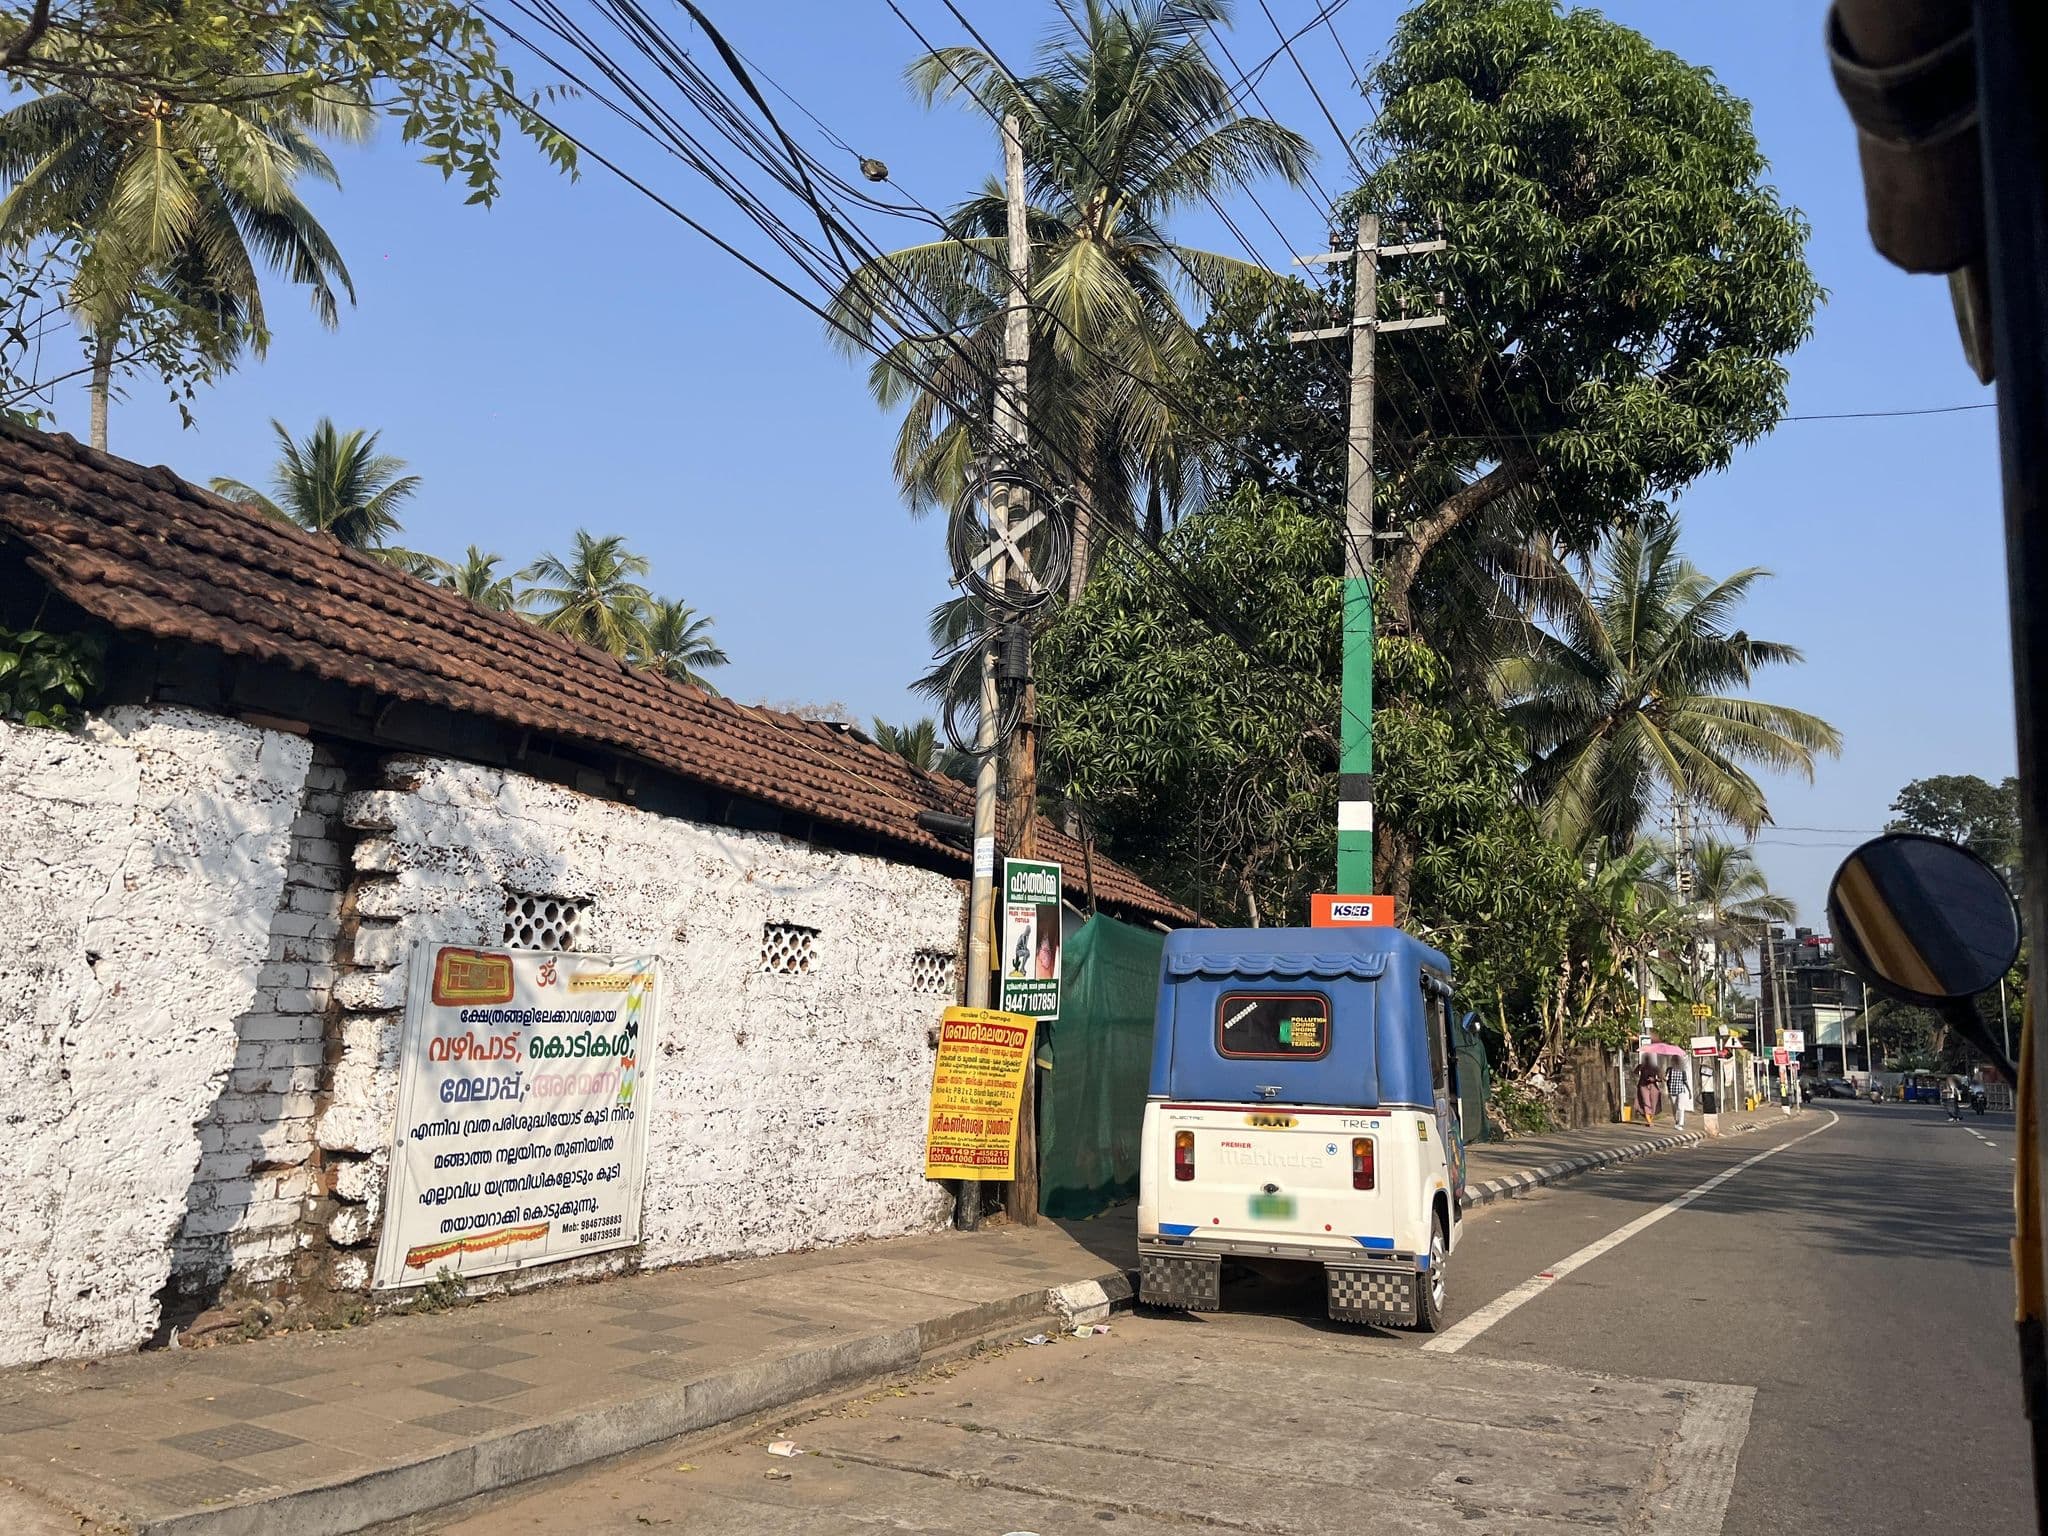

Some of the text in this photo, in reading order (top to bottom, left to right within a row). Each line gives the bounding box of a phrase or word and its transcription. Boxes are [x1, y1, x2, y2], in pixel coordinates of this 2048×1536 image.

[1005, 993, 1056, 1011] 9447107850
[945, 1023, 1025, 1047] ശബരിമലയാത്ര
[428, 1031, 522, 1063] വഴിപാട്,
[410, 1105, 635, 1140] എന്നിവ വ്രത പരിശുദ്ധിയോട് കൂടി നിറം
[1252, 1115, 1292, 1128] TAXI
[434, 1136, 614, 1169] മങ്ങാത്ത നല്ലയിനം തുണിയിൽ
[1221, 1141, 1252, 1149] PREMIER
[419, 1181, 481, 1206] എല്ലാവിധ
[596, 1163, 621, 1182] കൂടി
[562, 1215, 622, 1234] Mob: 9846738883
[580, 1227, 621, 1244] 9048739588
